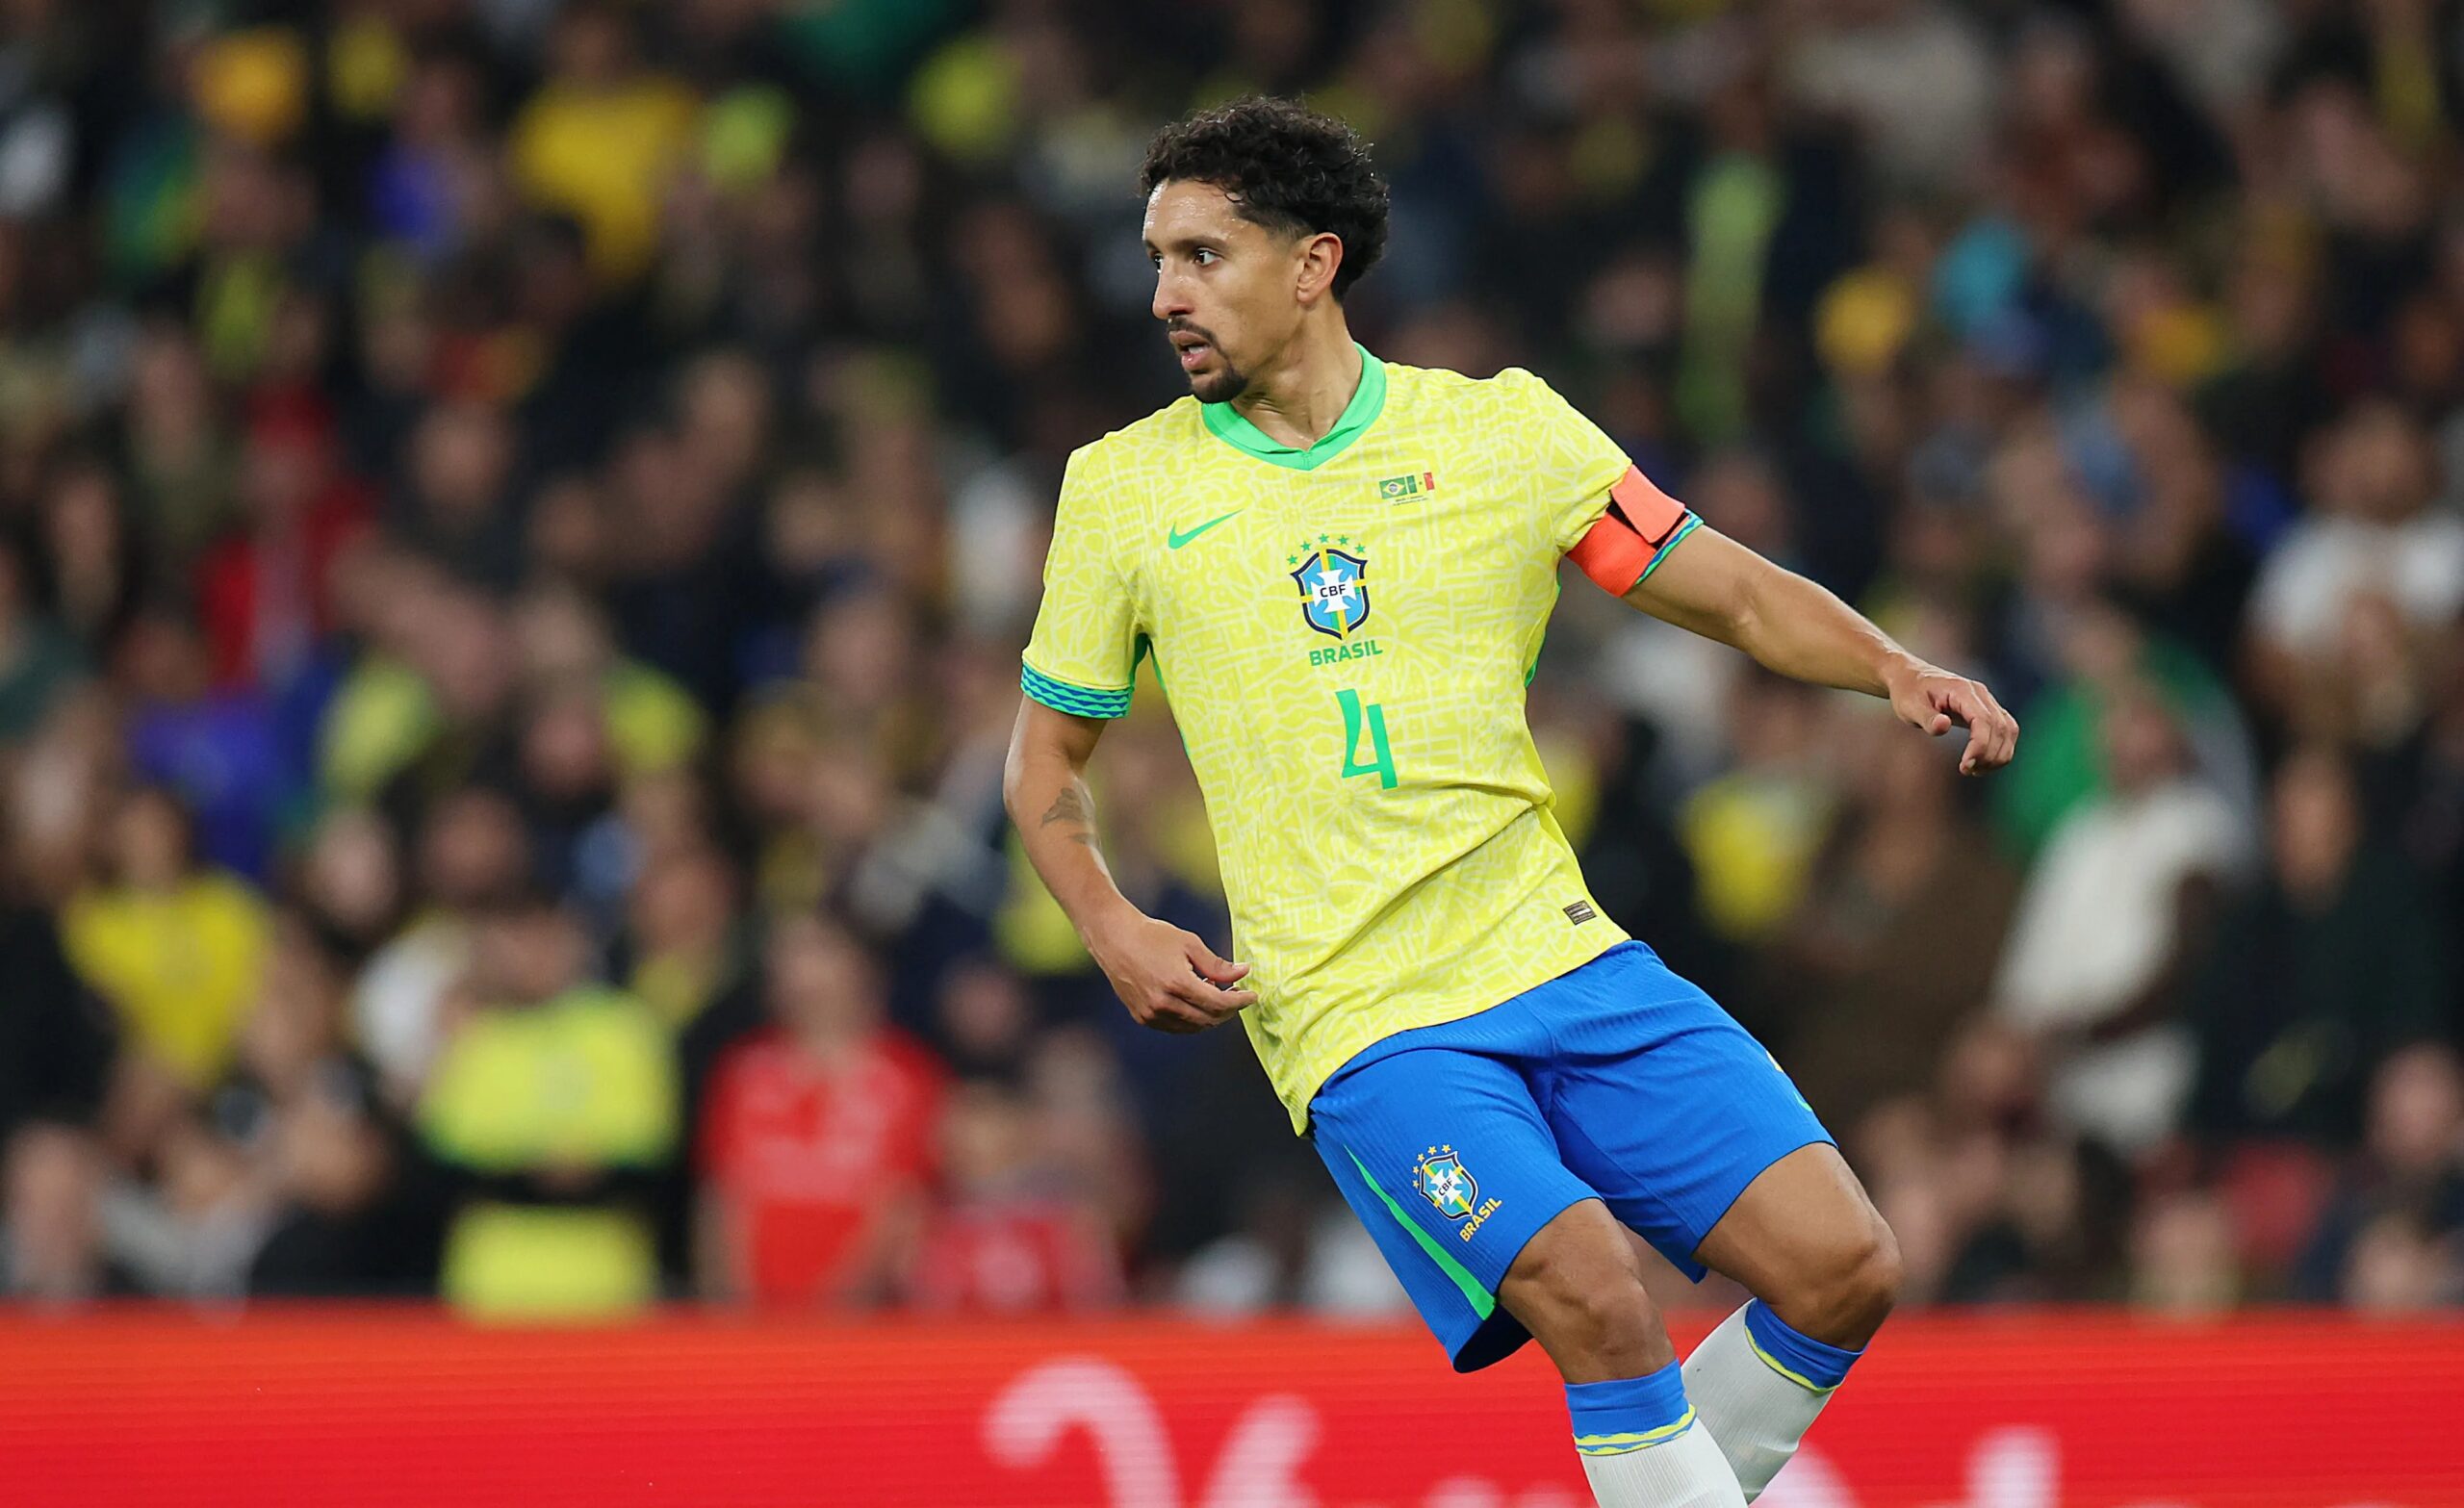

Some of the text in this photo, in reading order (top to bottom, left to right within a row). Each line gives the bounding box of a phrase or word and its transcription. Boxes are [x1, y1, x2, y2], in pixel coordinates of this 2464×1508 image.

[1320, 584, 1346, 598] CBF
[1309, 639, 1383, 666] BRASIL
[1335, 688, 1398, 790] 4
[1438, 1177, 1454, 1196] CBF
[1458, 1197, 1502, 1242] BRASIL
